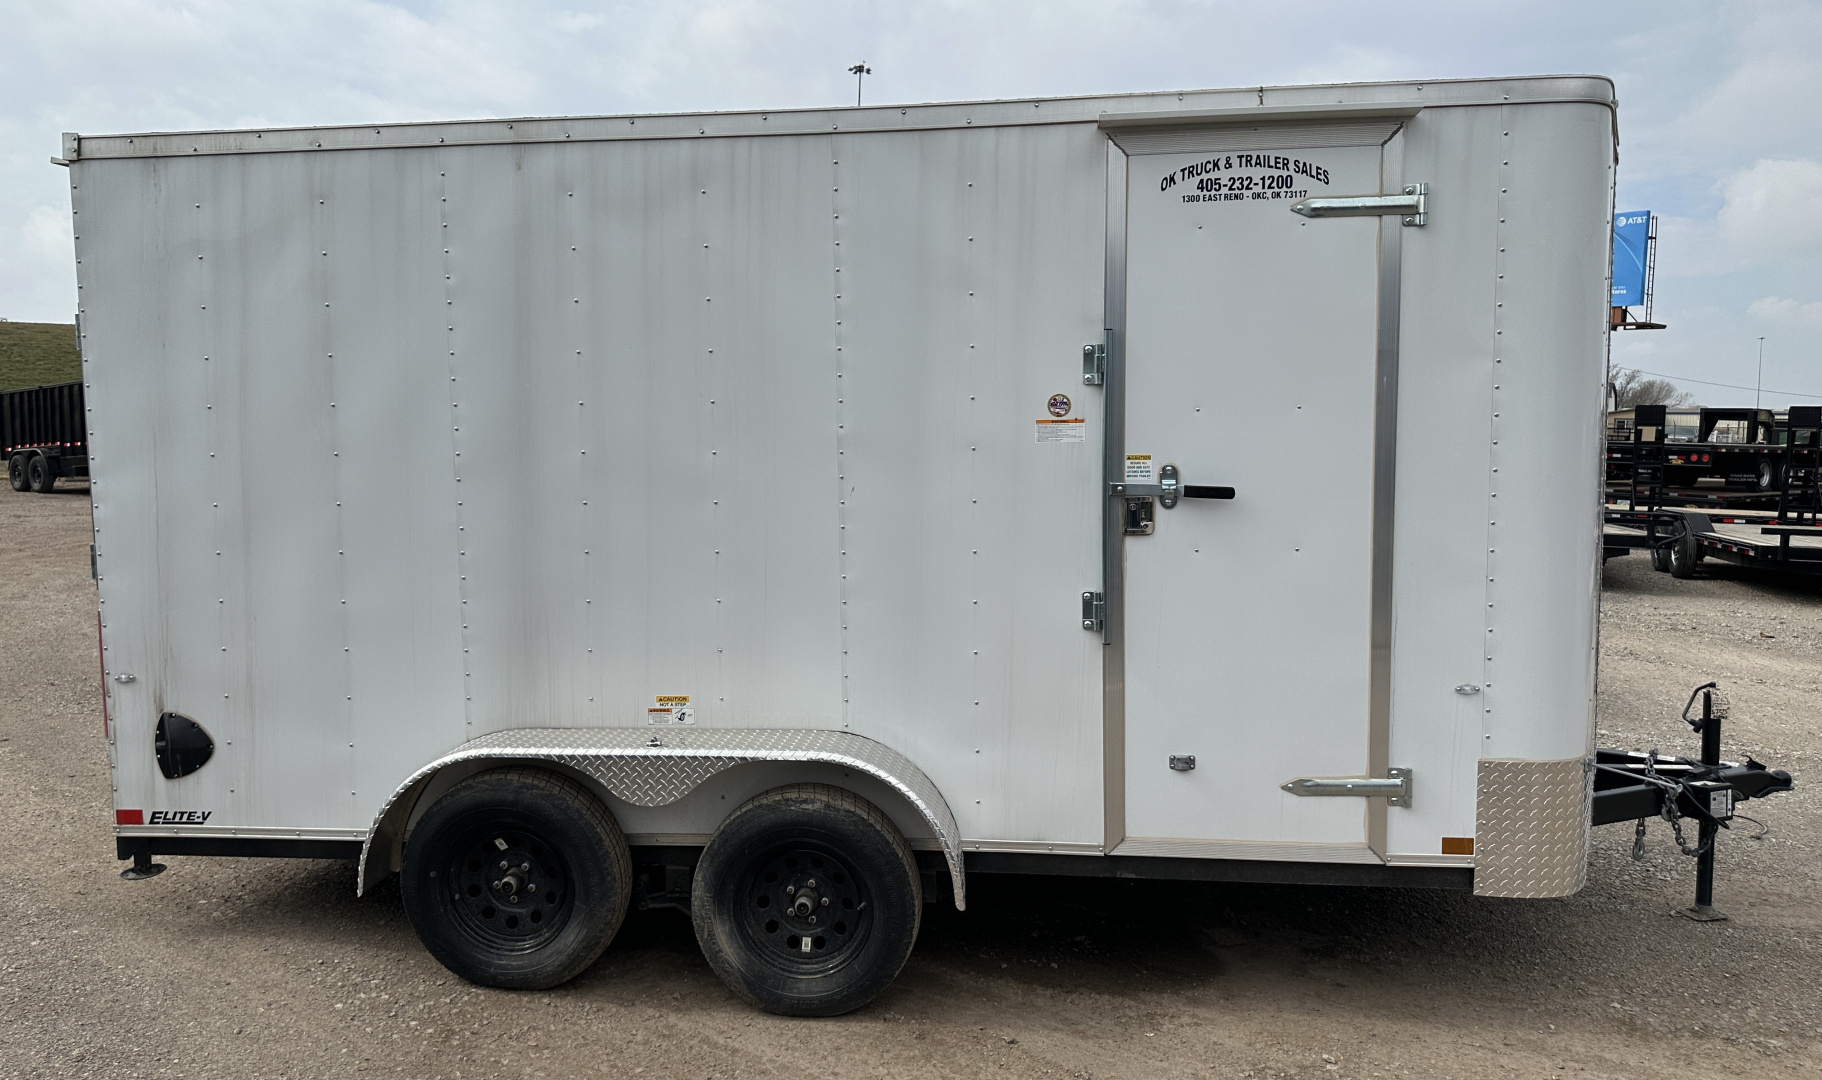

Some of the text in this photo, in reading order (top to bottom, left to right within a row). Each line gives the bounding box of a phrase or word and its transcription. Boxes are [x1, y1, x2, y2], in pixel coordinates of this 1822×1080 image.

[1160, 154, 1330, 192] OK TRUCK & TRAILER SALES
[1196, 174, 1294, 193] 405-232-1200
[1182, 193, 1201, 203] 1300
[1202, 193, 1223, 202] EAST
[1223, 192, 1244, 201] RENO
[1251, 191, 1270, 201] OKC,
[1271, 191, 1282, 200] OK
[1284, 190, 1308, 199] 73117
[1627, 216, 1647, 225] AT&T
[149, 811, 213, 825] ELITE-V
